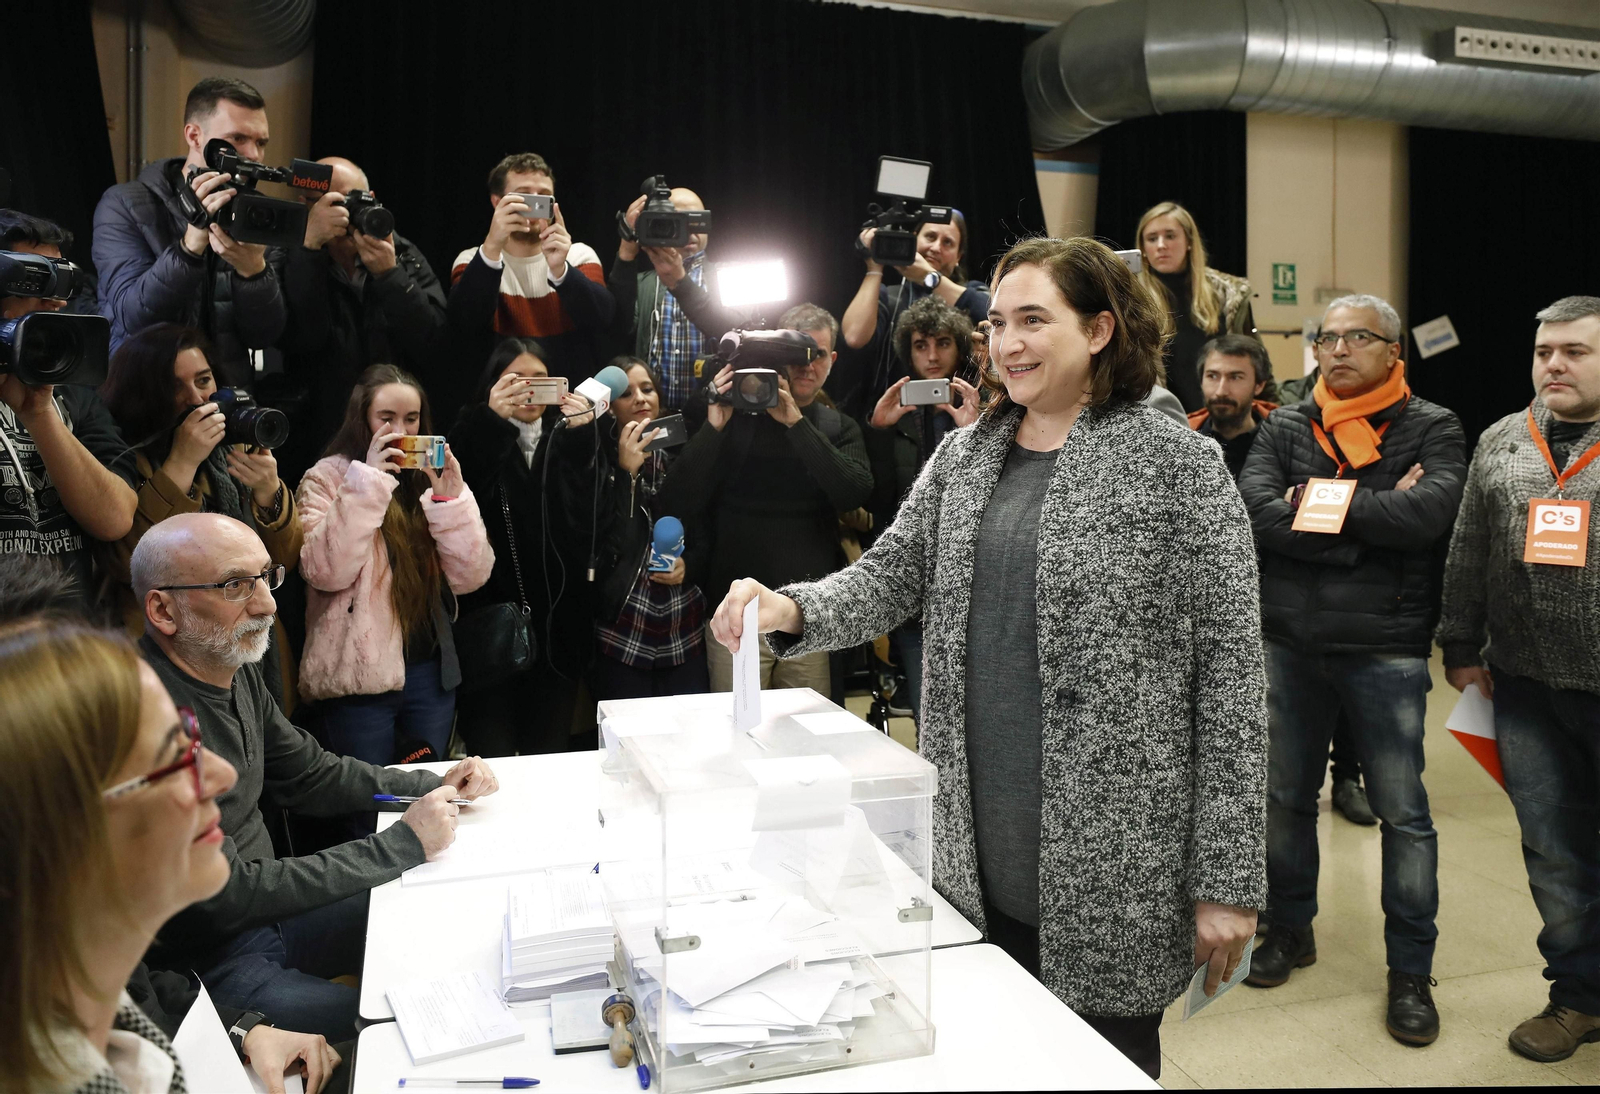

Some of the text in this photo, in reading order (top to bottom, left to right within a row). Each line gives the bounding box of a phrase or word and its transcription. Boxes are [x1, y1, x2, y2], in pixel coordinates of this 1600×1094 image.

[292, 174, 329, 190] betevé
[1316, 488, 1343, 500] C's
[1541, 510, 1575, 526] C's
[15, 529, 29, 538] AND
[1533, 541, 1578, 550] APODERADO
